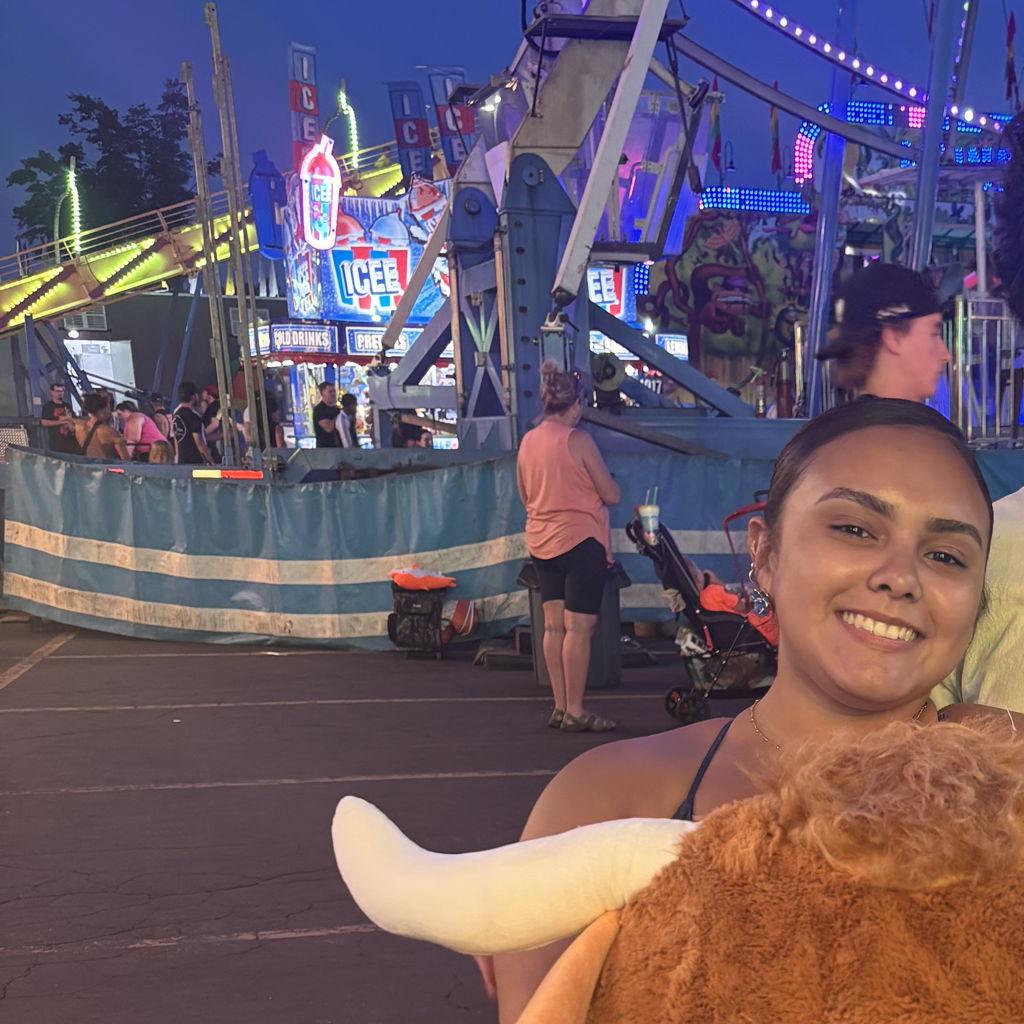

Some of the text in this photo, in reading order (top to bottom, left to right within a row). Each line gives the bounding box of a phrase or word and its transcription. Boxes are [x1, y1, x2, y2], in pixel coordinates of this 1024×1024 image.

[302, 56, 317, 154] ICE
[341, 259, 400, 296] ICEE
[292, 331, 330, 347] DRINKS
